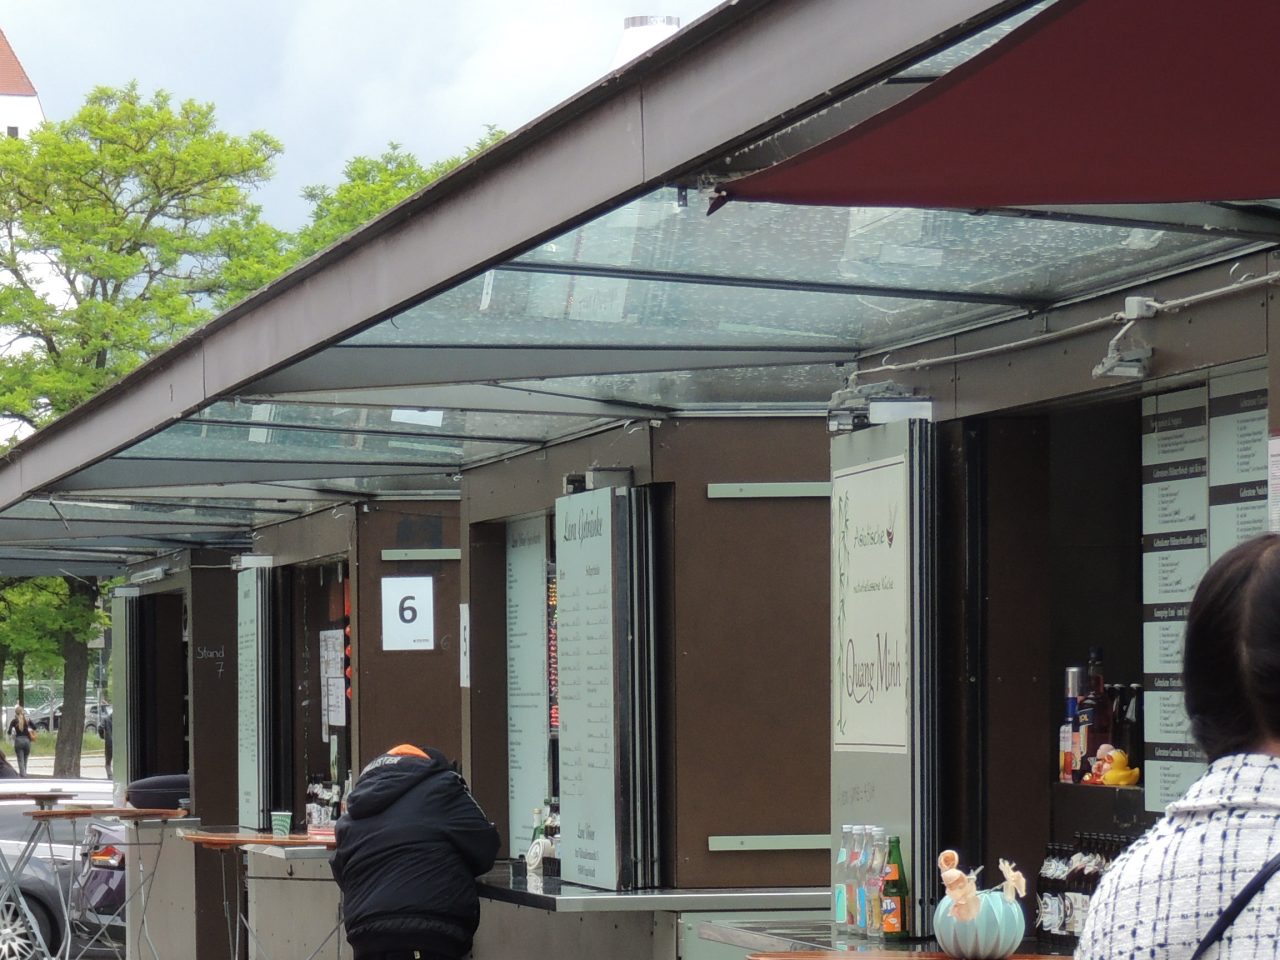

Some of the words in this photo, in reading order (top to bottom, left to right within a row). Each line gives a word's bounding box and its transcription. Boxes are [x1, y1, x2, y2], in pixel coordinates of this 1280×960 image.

[398, 595, 418, 623] 6
[196, 644, 225, 660] Stand
[215, 661, 225, 679] 7
[845, 638, 875, 704] Quang
[876, 631, 901, 692] Minh
